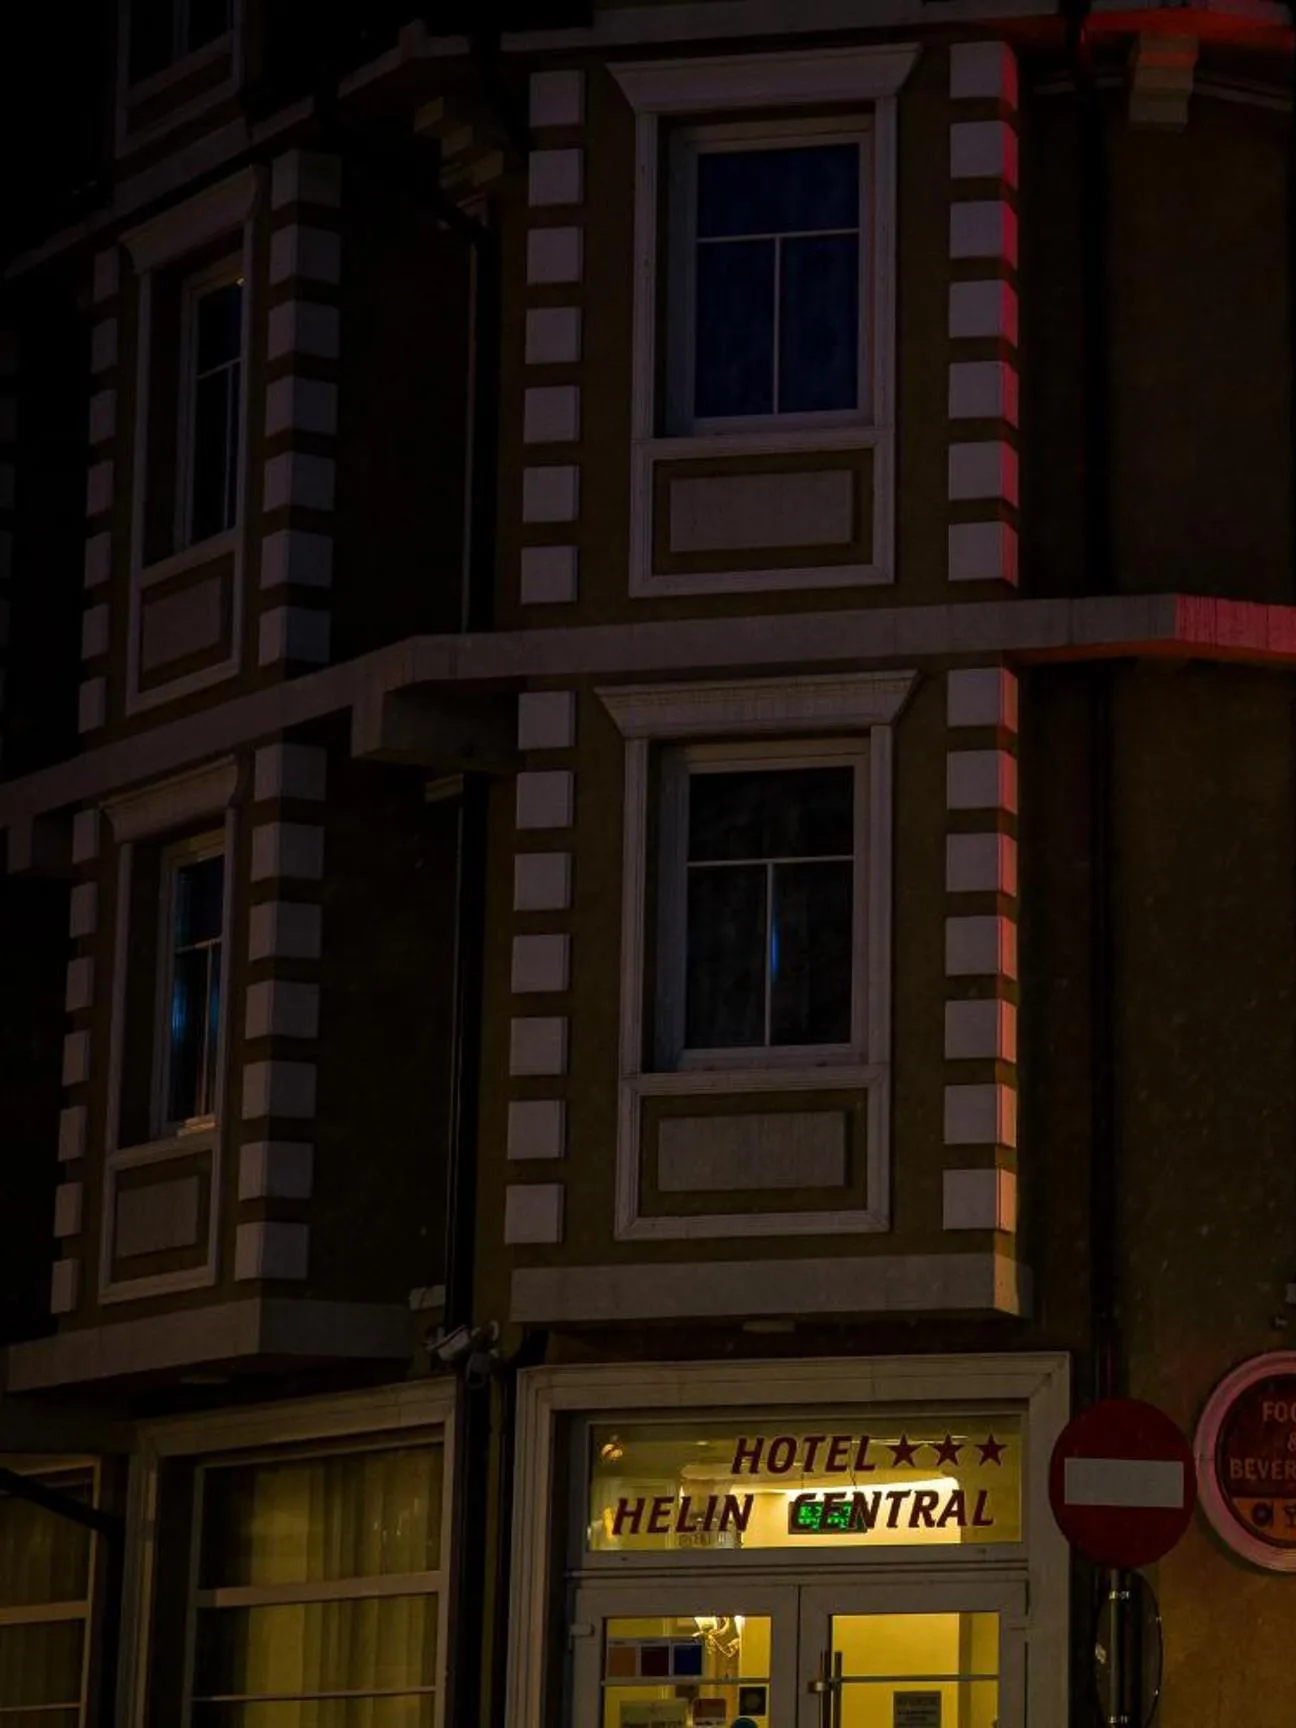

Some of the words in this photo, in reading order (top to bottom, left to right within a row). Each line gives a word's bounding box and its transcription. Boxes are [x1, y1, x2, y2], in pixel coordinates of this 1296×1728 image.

[731, 1435, 876, 1474] HOTEL
[612, 1494, 754, 1535] HELIN
[792, 1489, 995, 1530] CENTRAL
